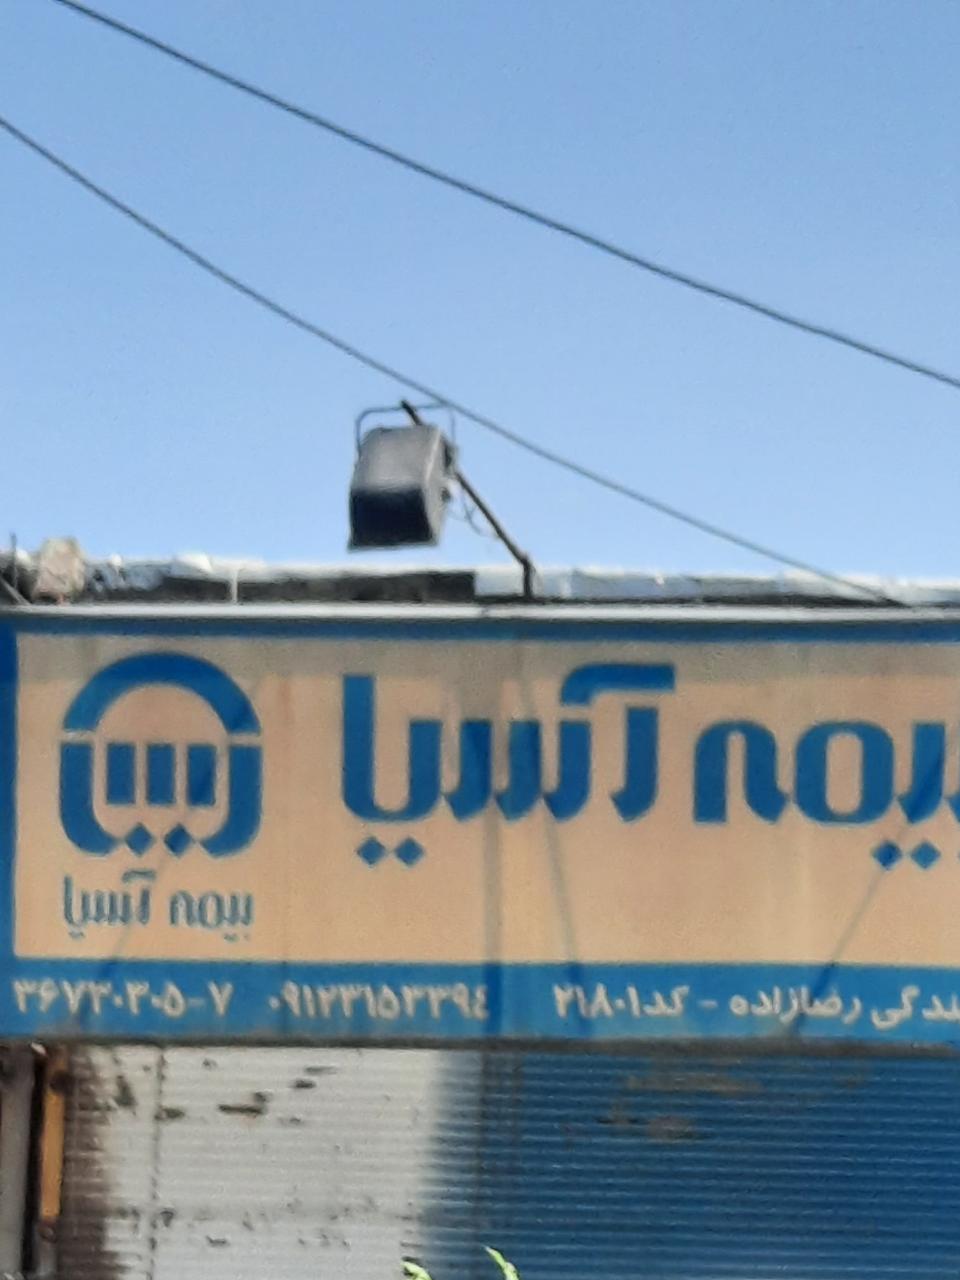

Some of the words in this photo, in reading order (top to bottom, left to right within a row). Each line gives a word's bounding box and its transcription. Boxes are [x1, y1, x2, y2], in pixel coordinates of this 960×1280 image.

[341, 661, 678, 870] آسیا
[62, 867, 157, 941] آسیا
[168, 889, 254, 942] بیمه
